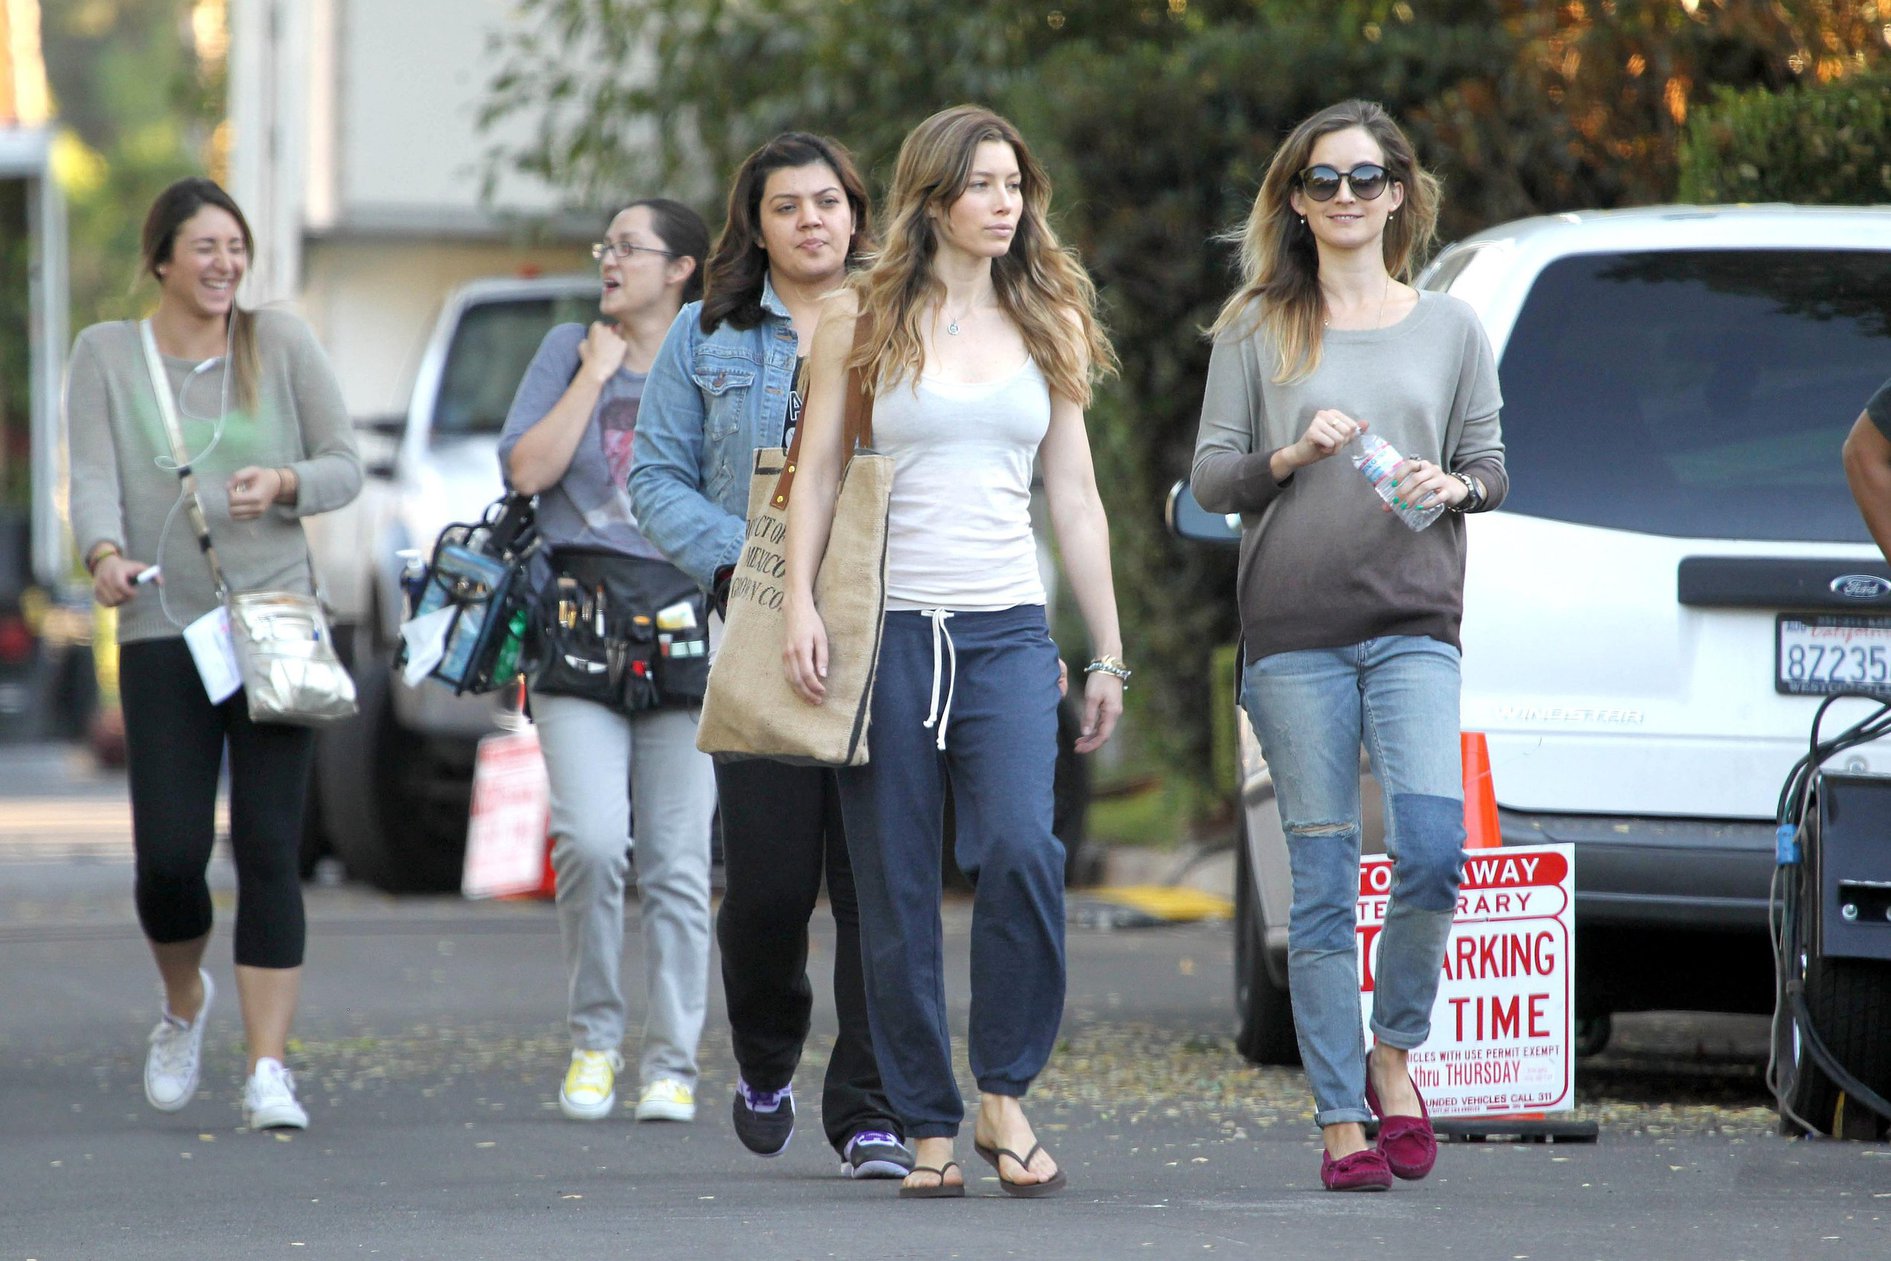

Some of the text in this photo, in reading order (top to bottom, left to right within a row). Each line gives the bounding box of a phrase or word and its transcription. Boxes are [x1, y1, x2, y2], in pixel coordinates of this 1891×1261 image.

[1788, 644, 1891, 682] 8Z235
[1448, 993, 1550, 1042] TIME
[1408, 1045, 1560, 1063] ICLES WITH USE PERMIT EXEMPT
[1414, 1065, 1440, 1088] thru
[1445, 1060, 1521, 1087] THURSDAY
[1425, 1091, 1552, 1108] UNDED VEHICLES CALL 311
